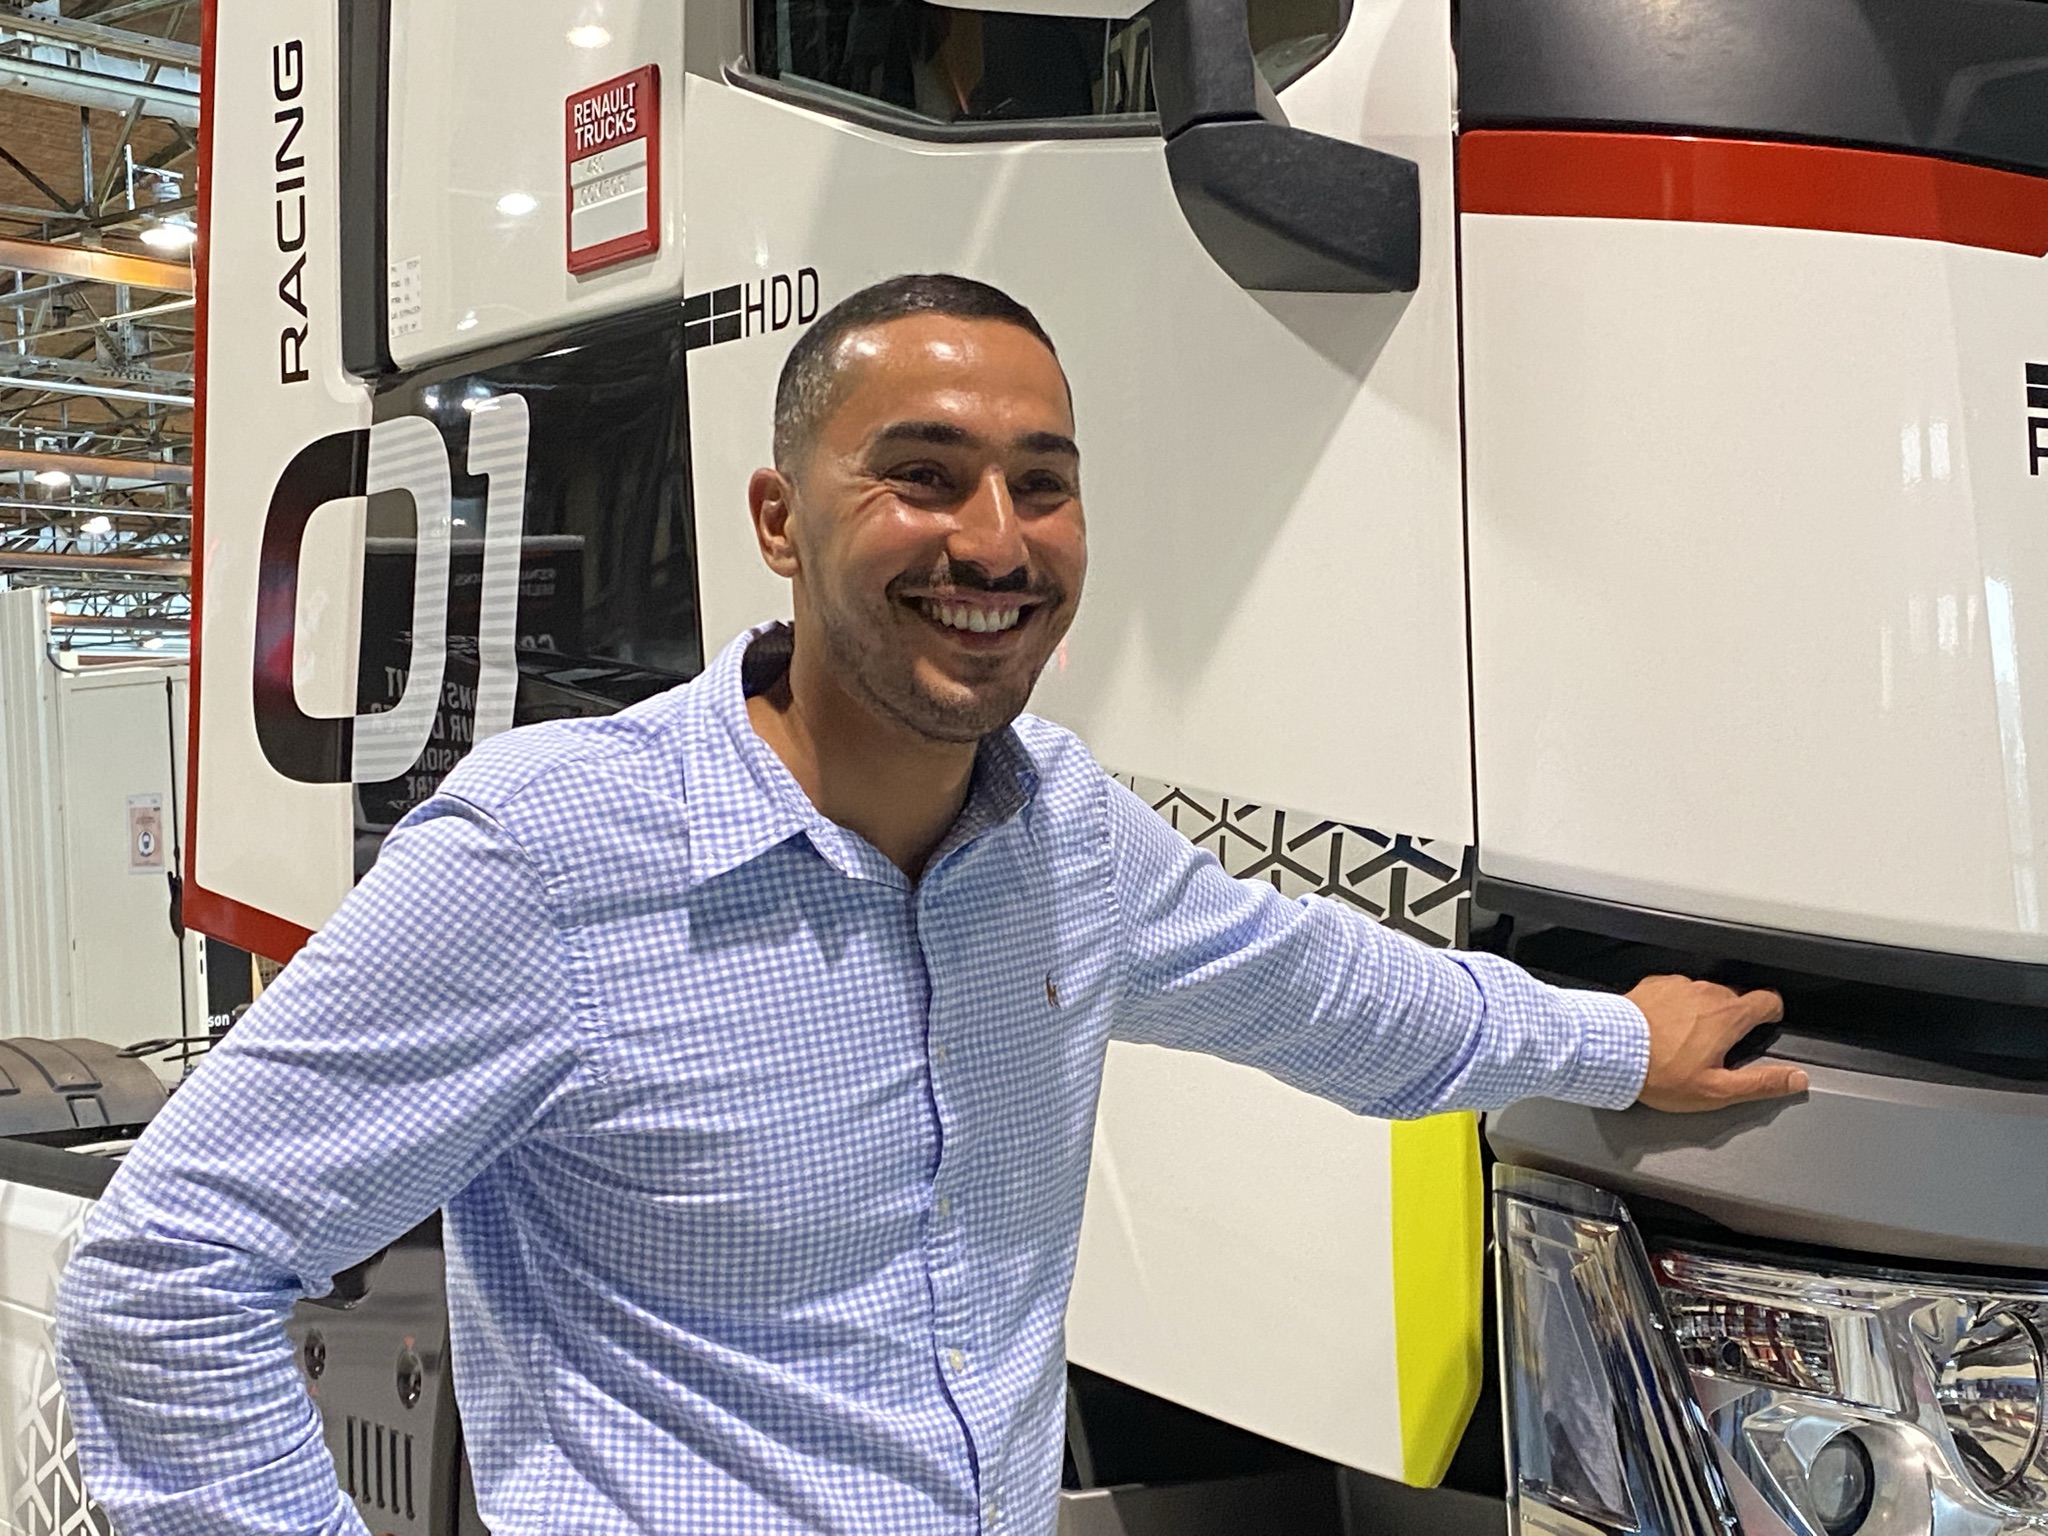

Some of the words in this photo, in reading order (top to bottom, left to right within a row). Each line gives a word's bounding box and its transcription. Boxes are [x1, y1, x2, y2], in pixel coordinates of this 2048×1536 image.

[573, 82, 637, 128] RENAULT
[574, 108, 637, 151] TRUCKS
[272, 38, 310, 385] RACING
[745, 266, 819, 338] HDD
[252, 392, 530, 784] 01
